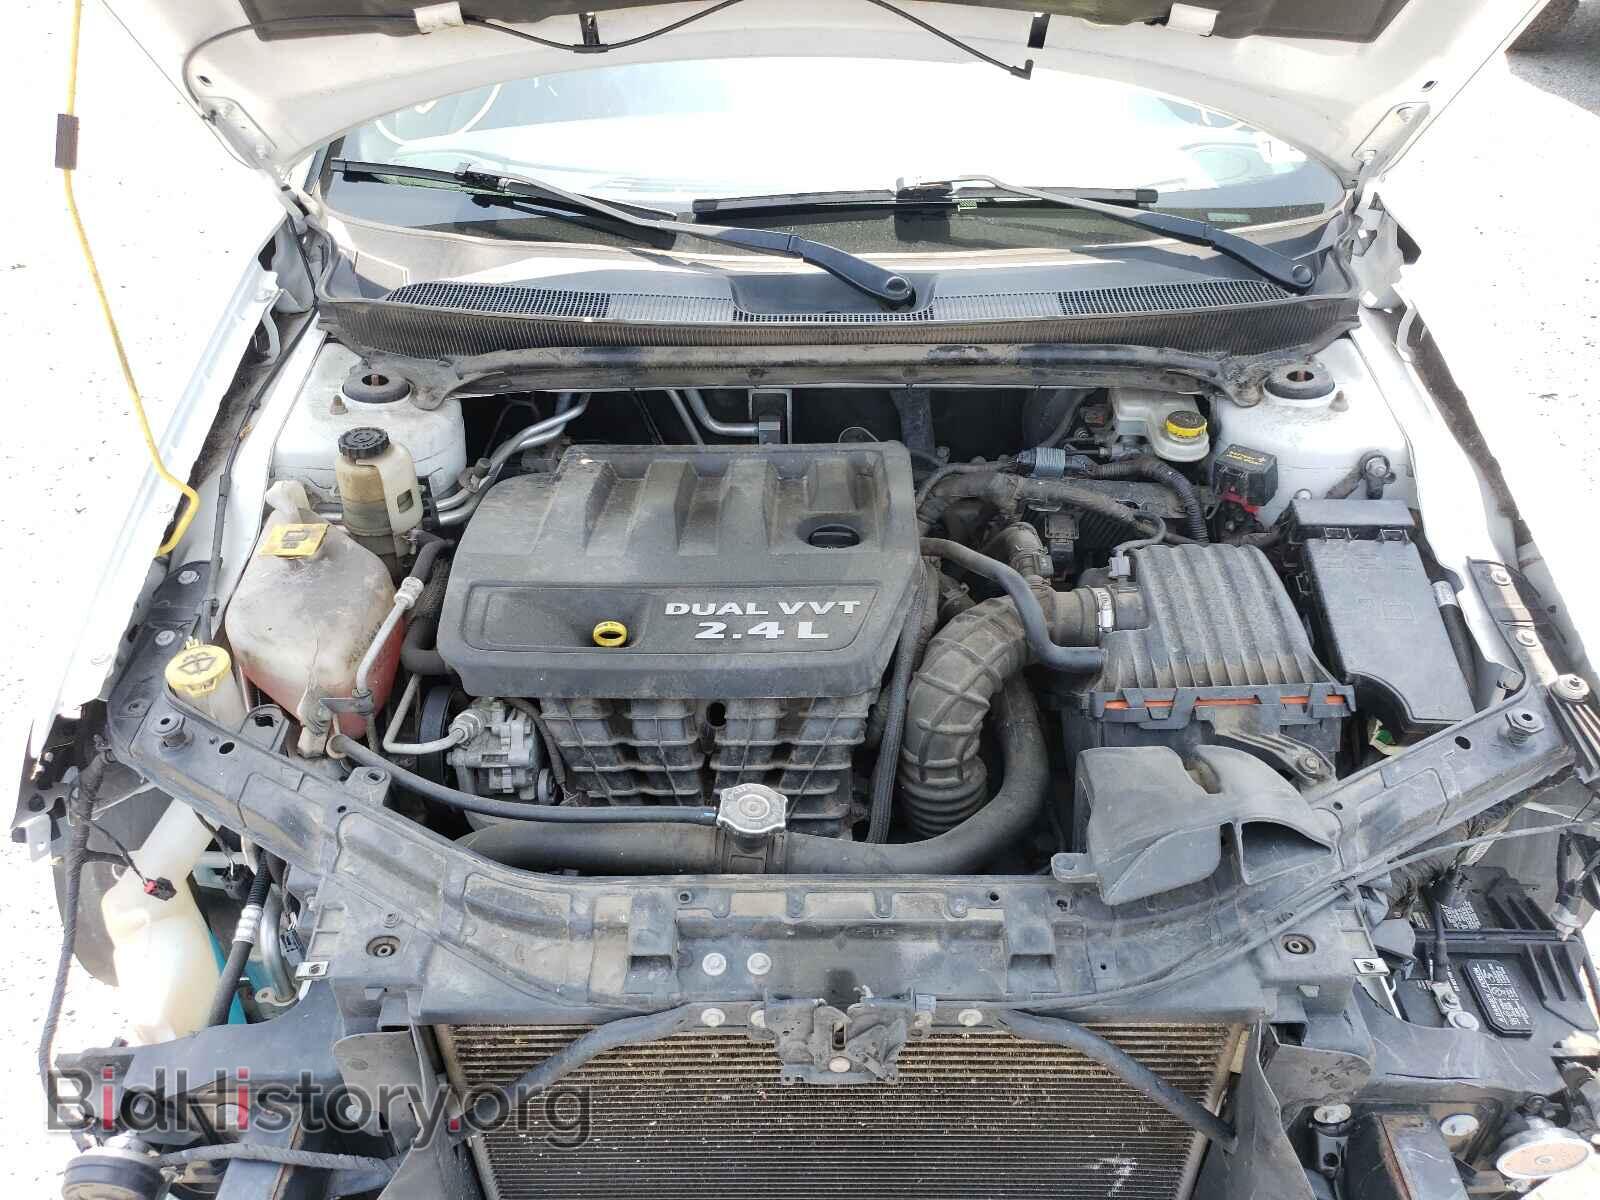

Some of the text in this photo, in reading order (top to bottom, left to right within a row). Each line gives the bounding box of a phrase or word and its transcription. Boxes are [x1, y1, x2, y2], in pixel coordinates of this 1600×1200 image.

[664, 600, 861, 616] DUAL VVT
[694, 621, 785, 639] 2.4
